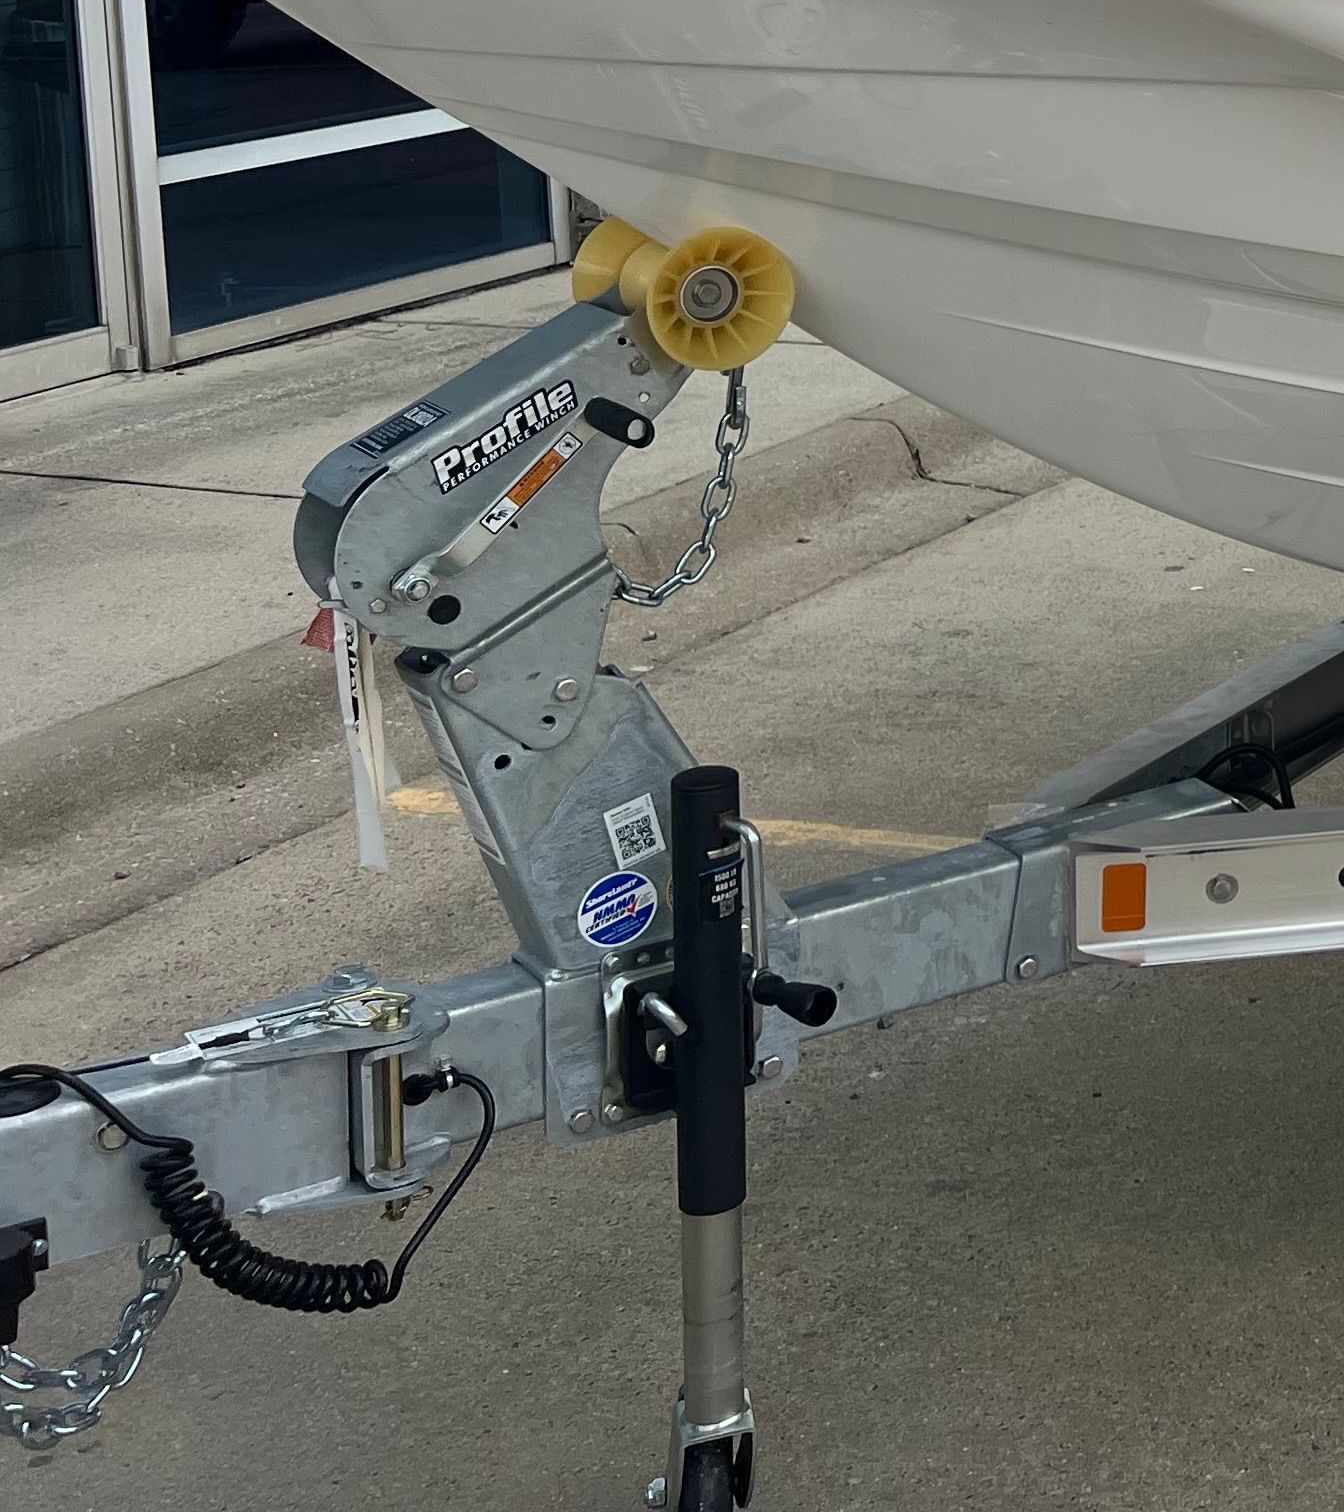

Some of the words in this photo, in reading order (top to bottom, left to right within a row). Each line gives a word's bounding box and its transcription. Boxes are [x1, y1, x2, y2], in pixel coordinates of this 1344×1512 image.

[433, 382, 573, 485] Profile
[442, 429, 532, 492] PERFORMANCE
[534, 401, 575, 431] WINCH
[585, 910, 626, 933] CERTIFIED
[593, 893, 636, 925] NMMA
